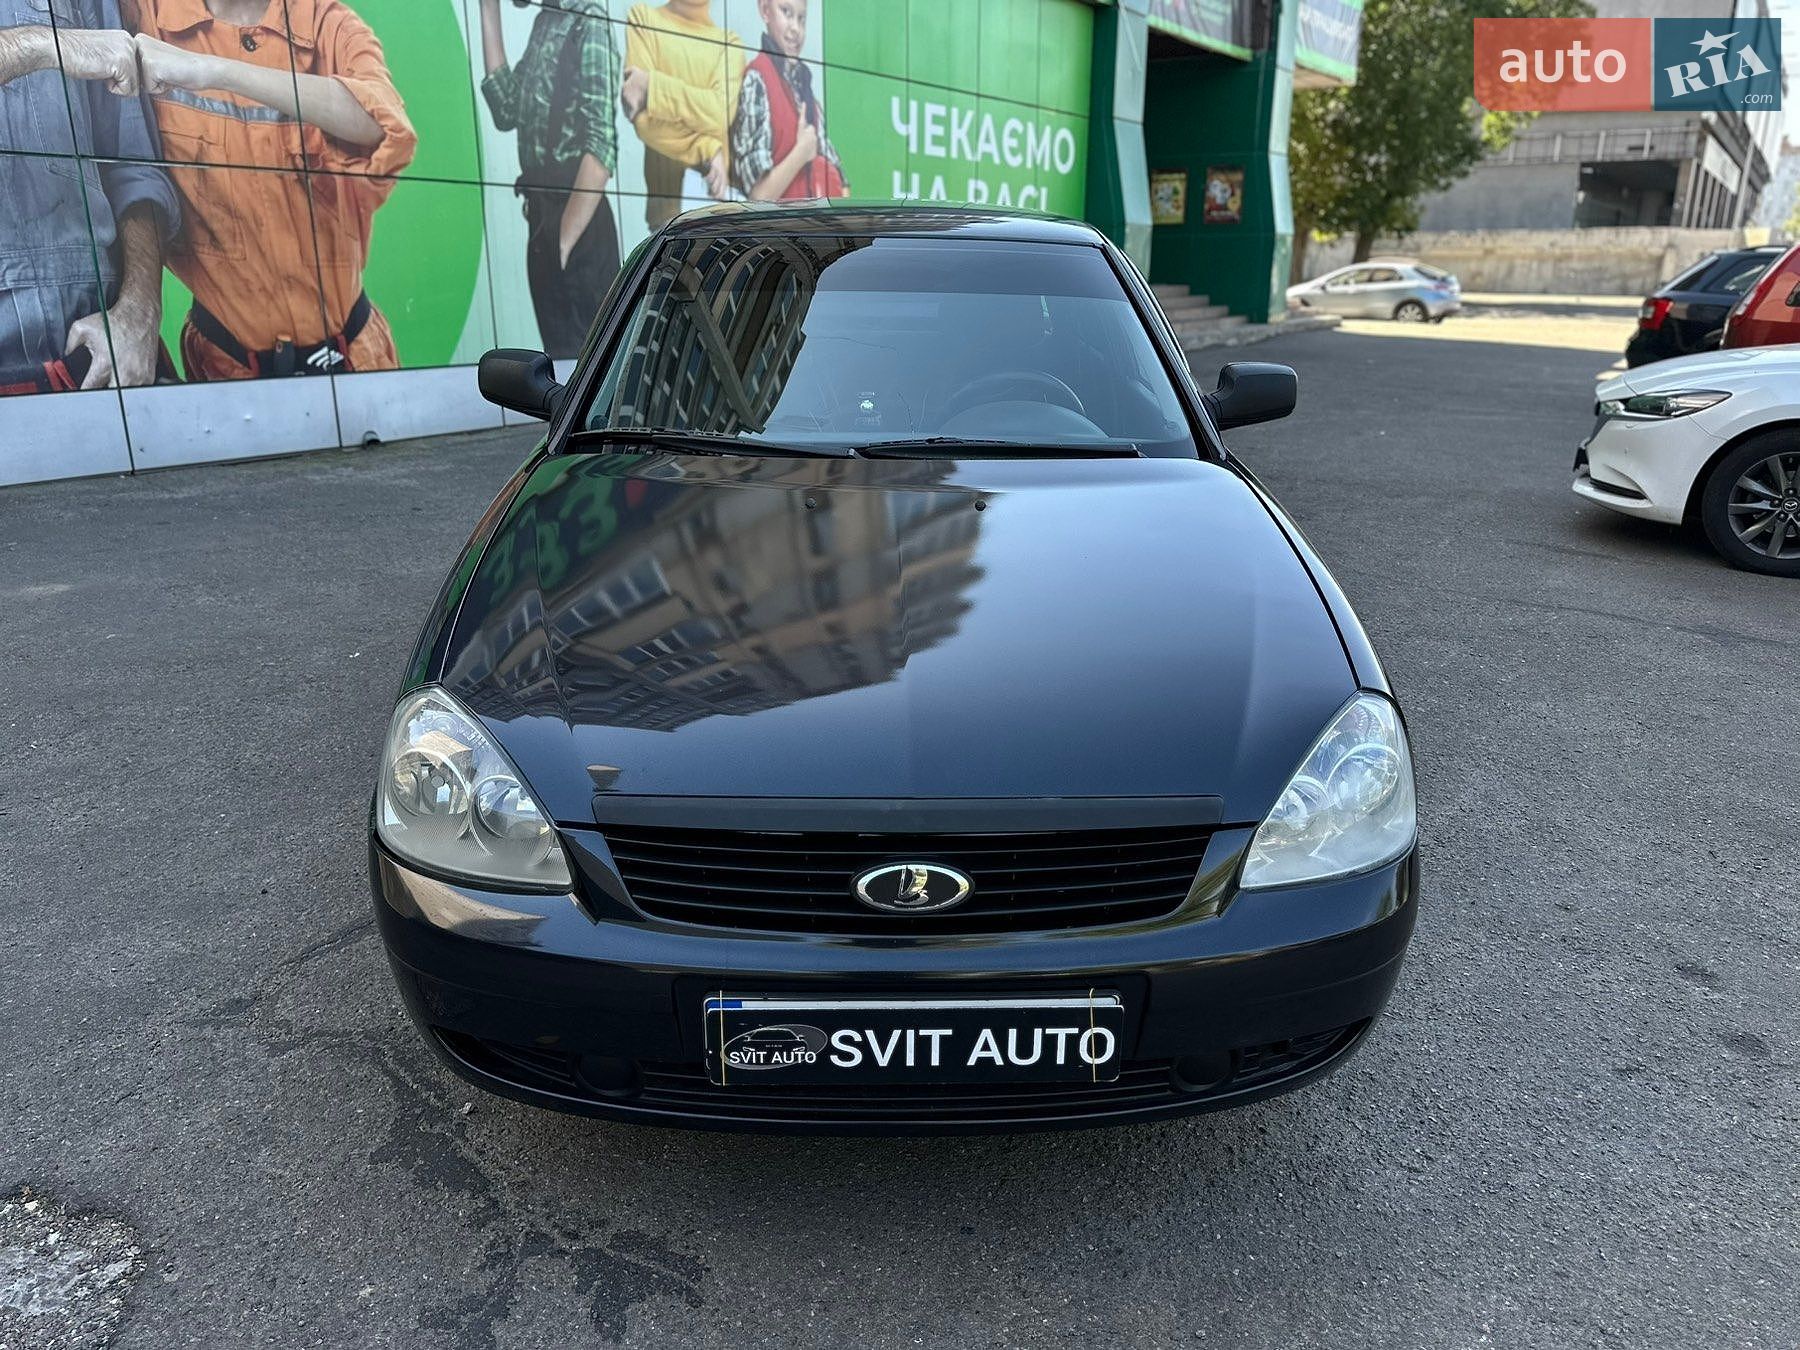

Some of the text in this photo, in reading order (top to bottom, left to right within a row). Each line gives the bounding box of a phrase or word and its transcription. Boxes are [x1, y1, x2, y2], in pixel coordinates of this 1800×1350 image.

[891, 96, 1075, 175] ЧЕКАЄМО
[729, 1051, 817, 1064] SVIT AUTO
[829, 1027, 1116, 1067] SVIT AUTO
